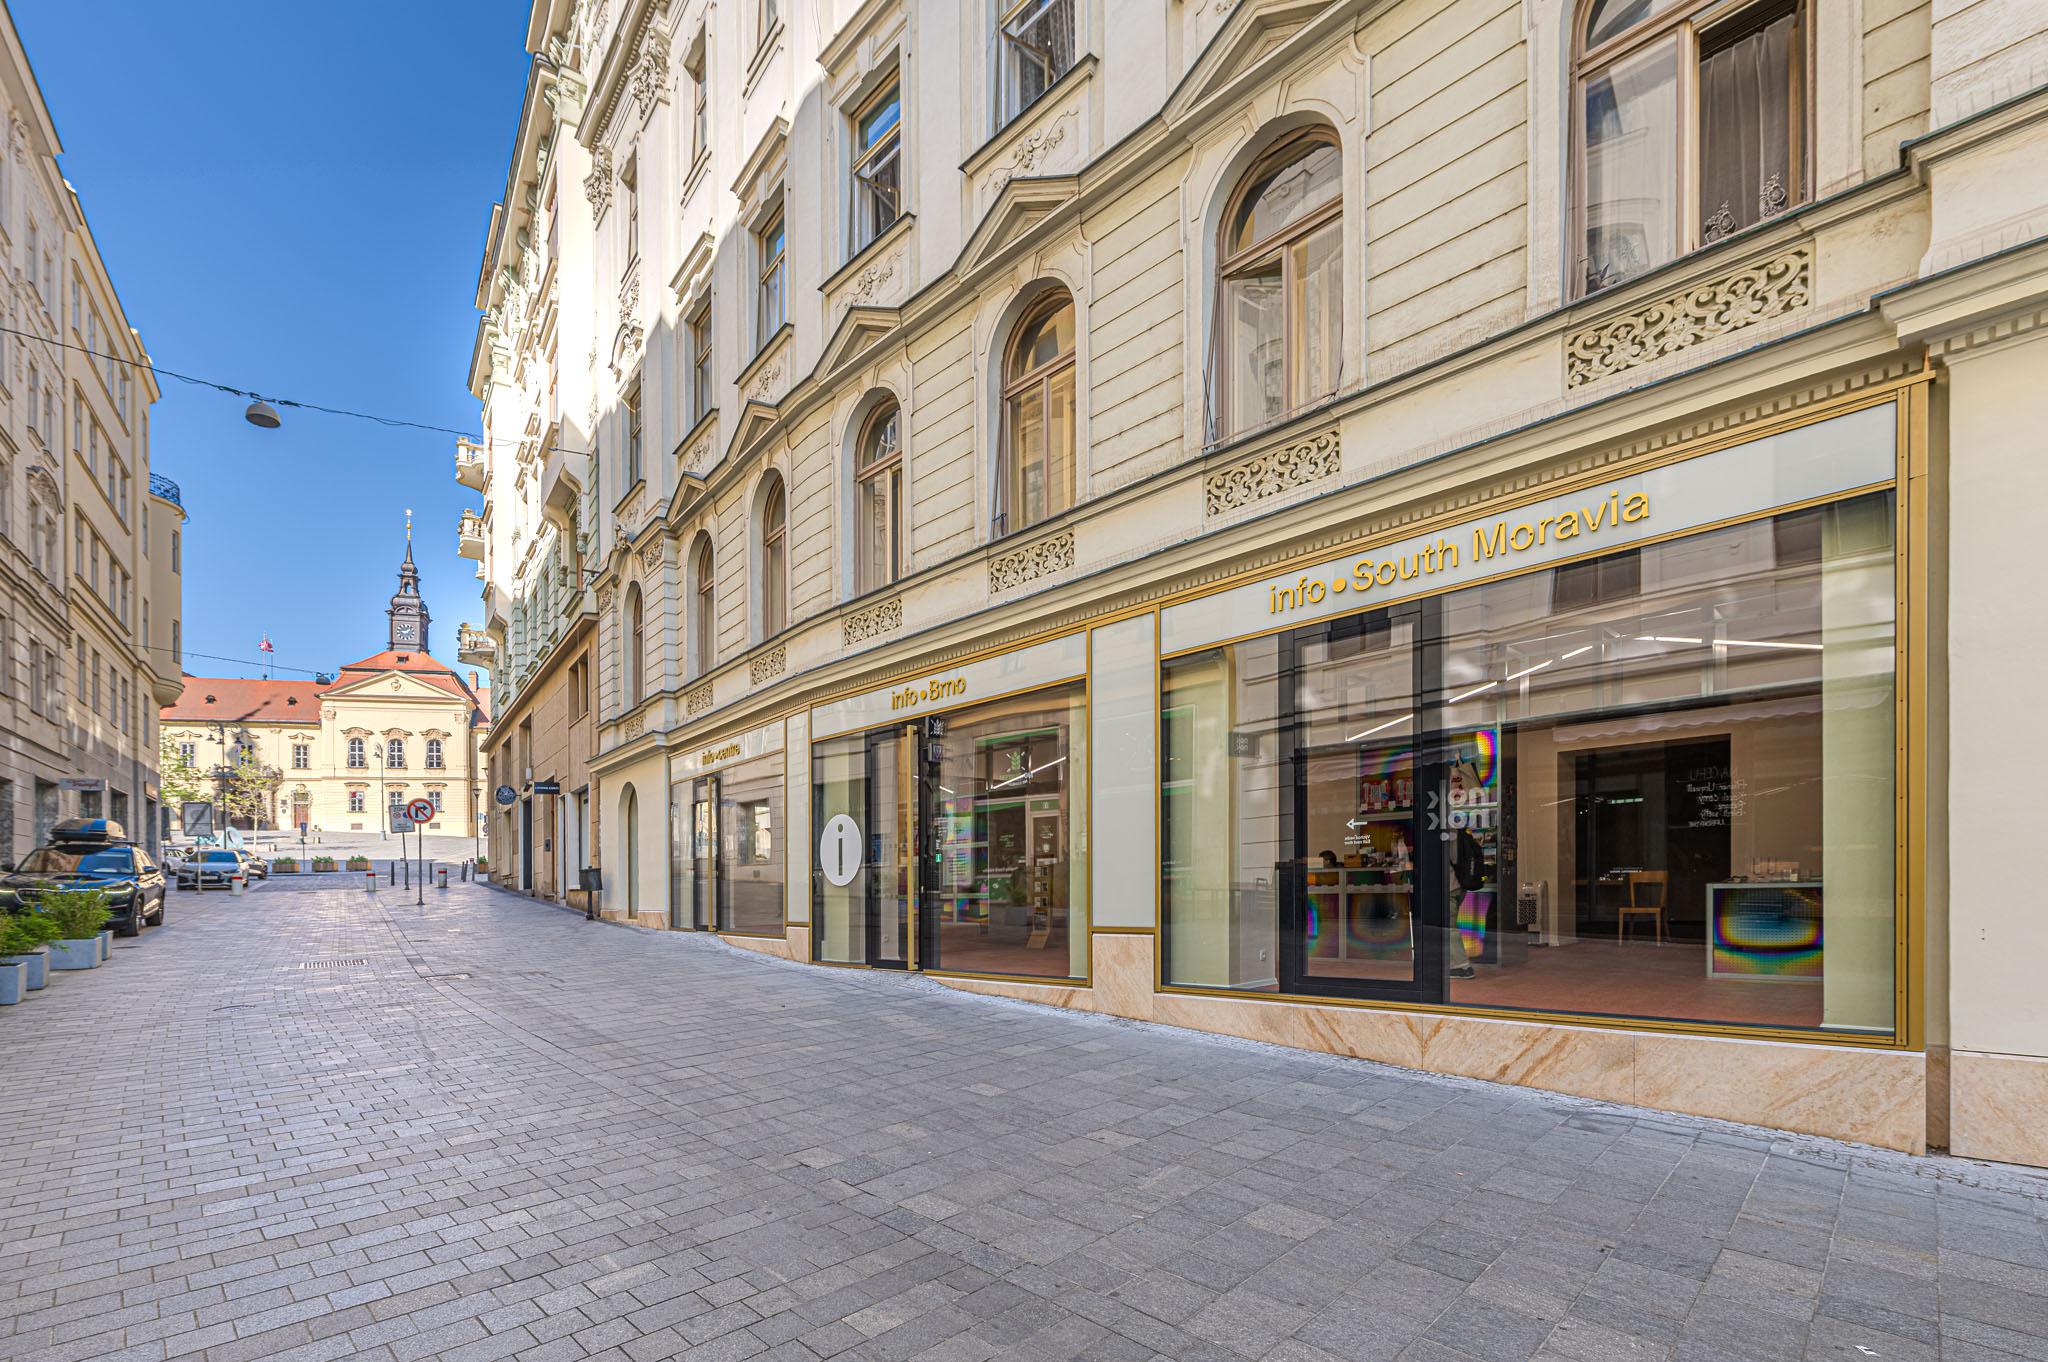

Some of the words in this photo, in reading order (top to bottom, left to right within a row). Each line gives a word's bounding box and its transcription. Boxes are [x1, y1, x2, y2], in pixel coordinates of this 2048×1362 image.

[1269, 576, 1327, 614] info
[1352, 538, 1460, 592] South
[1472, 490, 1651, 562] Moravia
[891, 687, 918, 711] info
[929, 677, 967, 701] Brno
